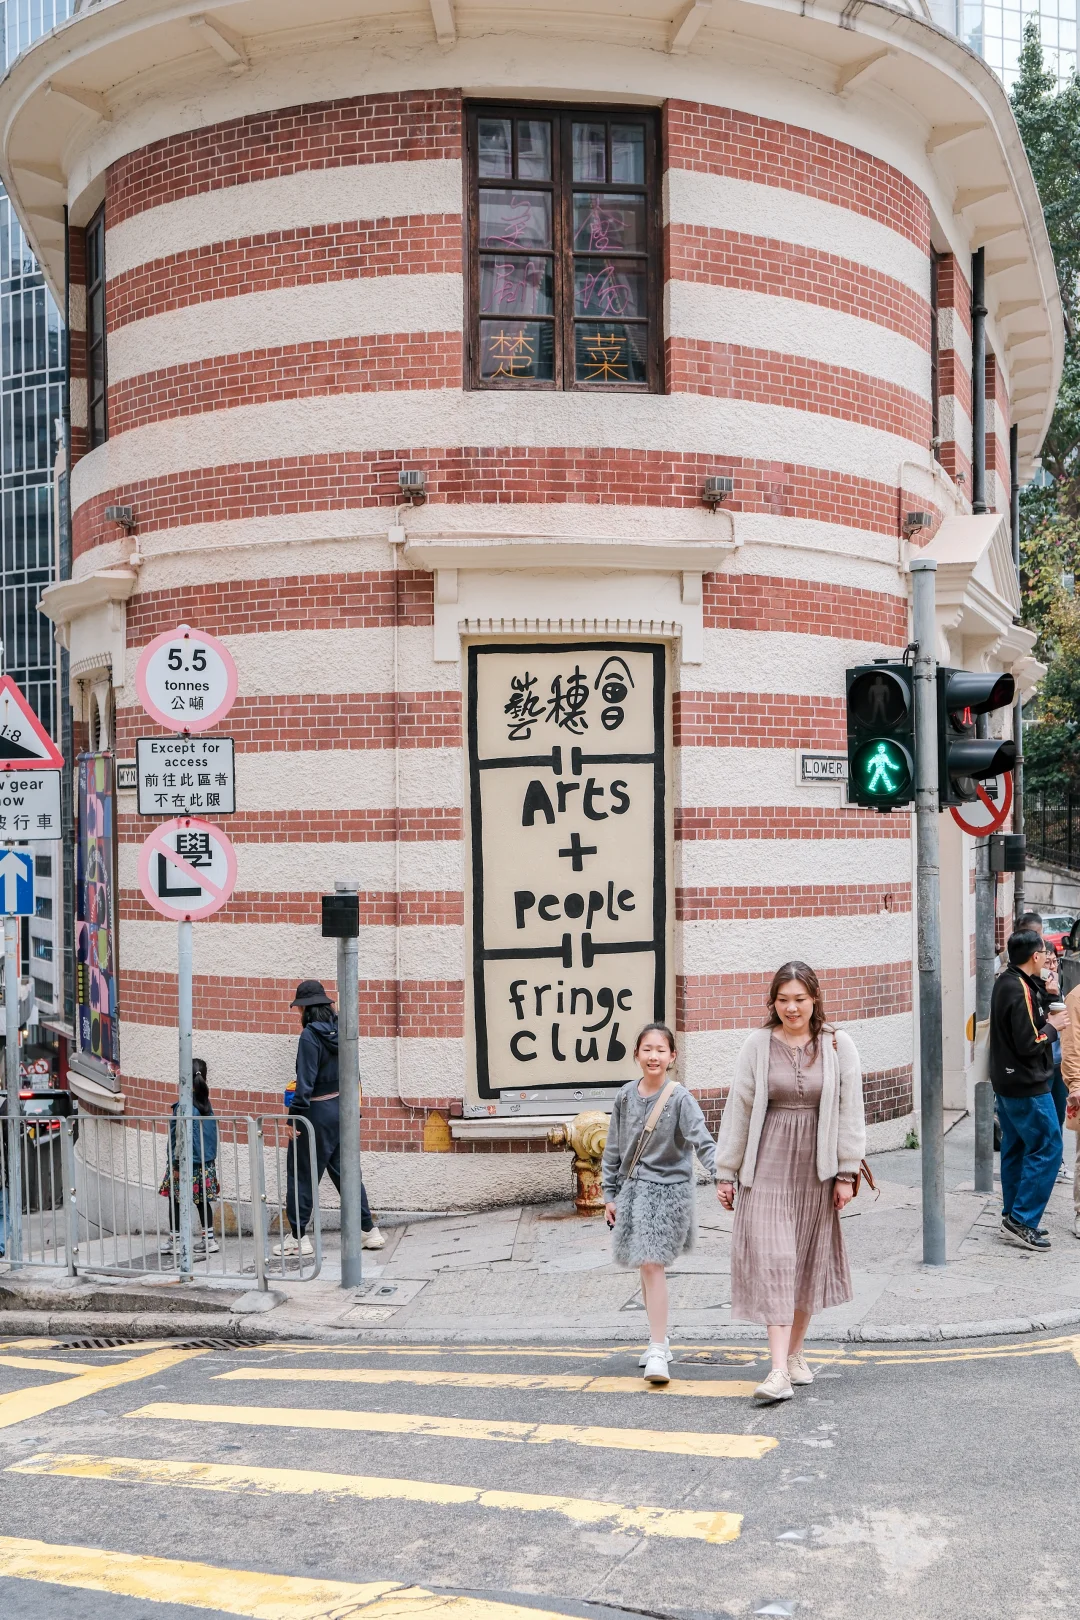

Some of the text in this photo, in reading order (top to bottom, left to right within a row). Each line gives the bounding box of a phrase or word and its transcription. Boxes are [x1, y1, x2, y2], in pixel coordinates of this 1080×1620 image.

[168, 648, 207, 672] 5.5
[165, 680, 210, 691] tonnes
[171, 695, 204, 711] 公噸
[503, 655, 636, 741] 藝穗會
[1, 724, 22, 743] 1:8
[151, 743, 220, 754] Except for
[164, 759, 208, 767] access
[805, 761, 843, 774] LOWER
[10, 780, 44, 793] gear
[145, 772, 229, 788] 前往此區者
[0, 797, 25, 807] ow
[154, 793, 221, 808] 不在此限
[522, 778, 631, 827] Arts
[174, 832, 213, 869] 學
[158, 852, 202, 898] L
